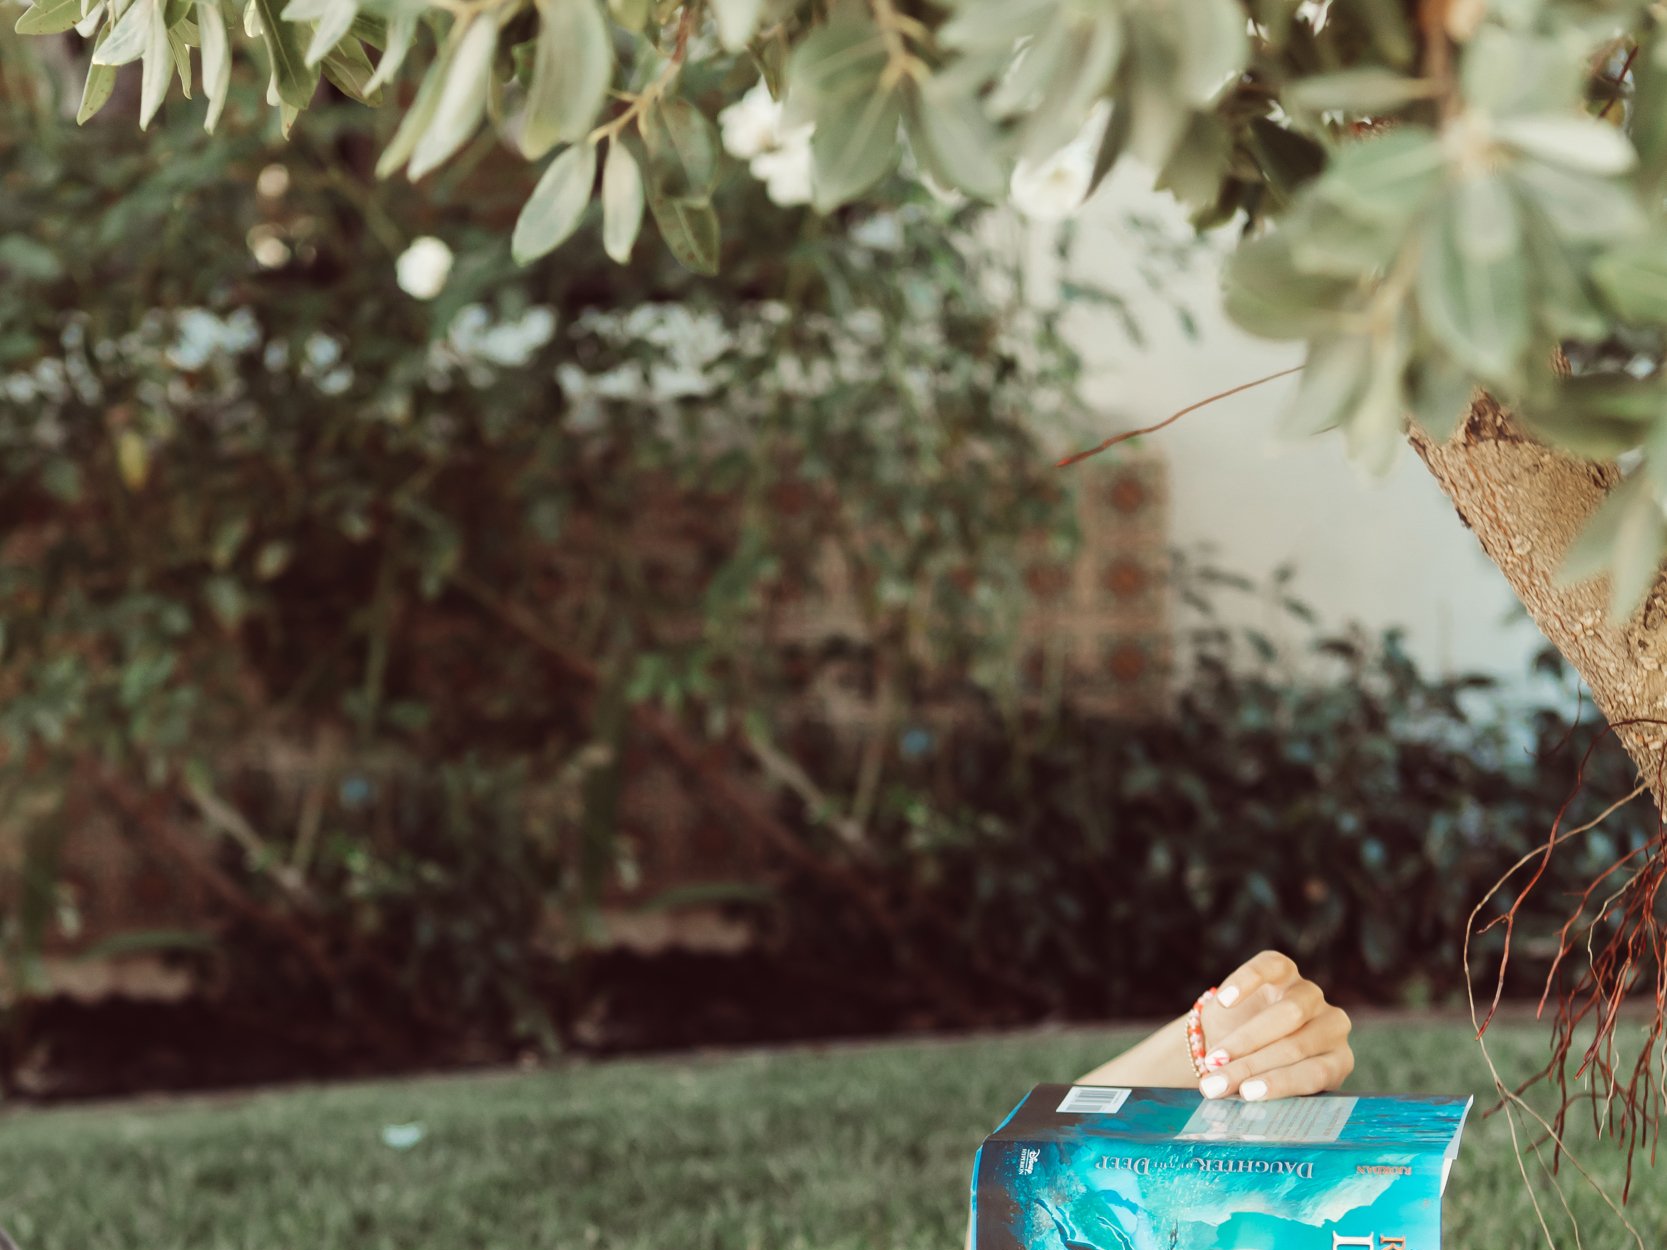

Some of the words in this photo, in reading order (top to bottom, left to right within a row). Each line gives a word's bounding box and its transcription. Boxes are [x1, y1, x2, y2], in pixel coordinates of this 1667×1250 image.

[1095, 1155, 1150, 1176] DEEP
[1192, 1157, 1314, 1179] DAUGHTER
[1356, 1165, 1412, 1176] RIORDAN
